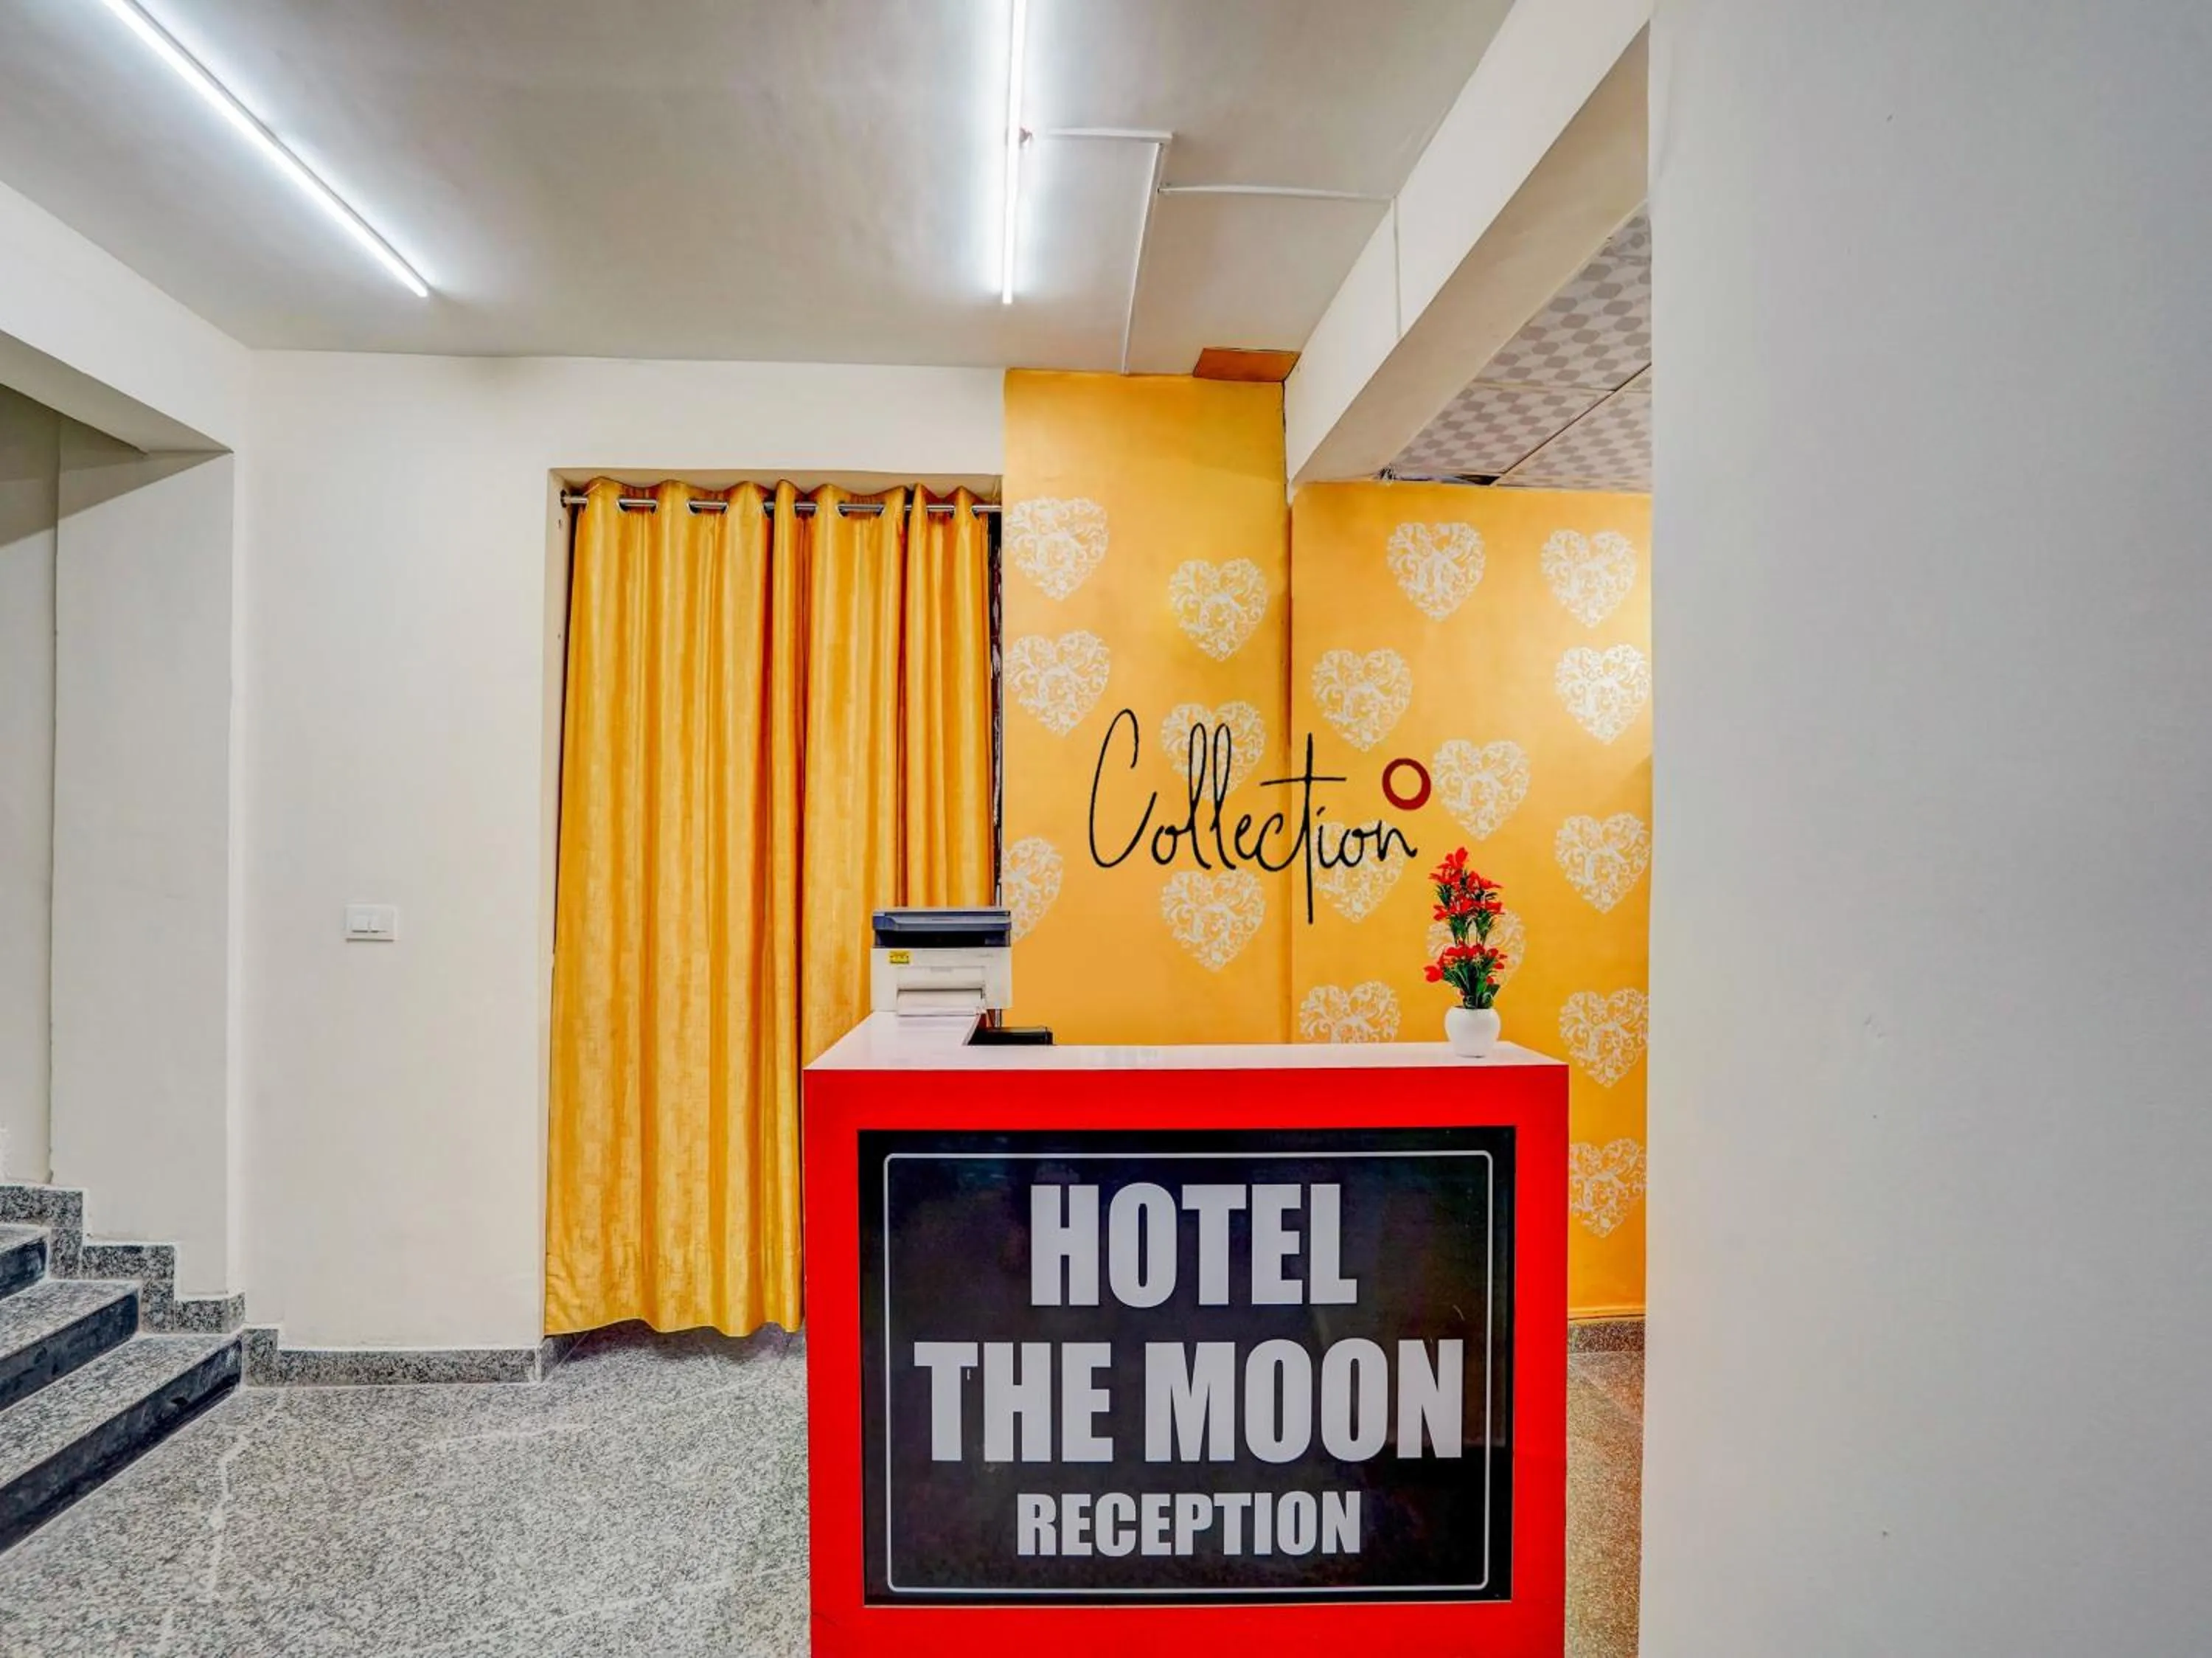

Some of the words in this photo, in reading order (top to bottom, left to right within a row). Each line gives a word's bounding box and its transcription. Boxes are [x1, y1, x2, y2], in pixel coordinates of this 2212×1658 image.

[1090, 709, 1417, 924] Collection
[1031, 1182, 1357, 1308] HOTEL
[914, 1342, 1113, 1463] THE
[1144, 1337, 1464, 1463] MOON
[1017, 1491, 1361, 1556] RECEPTION
